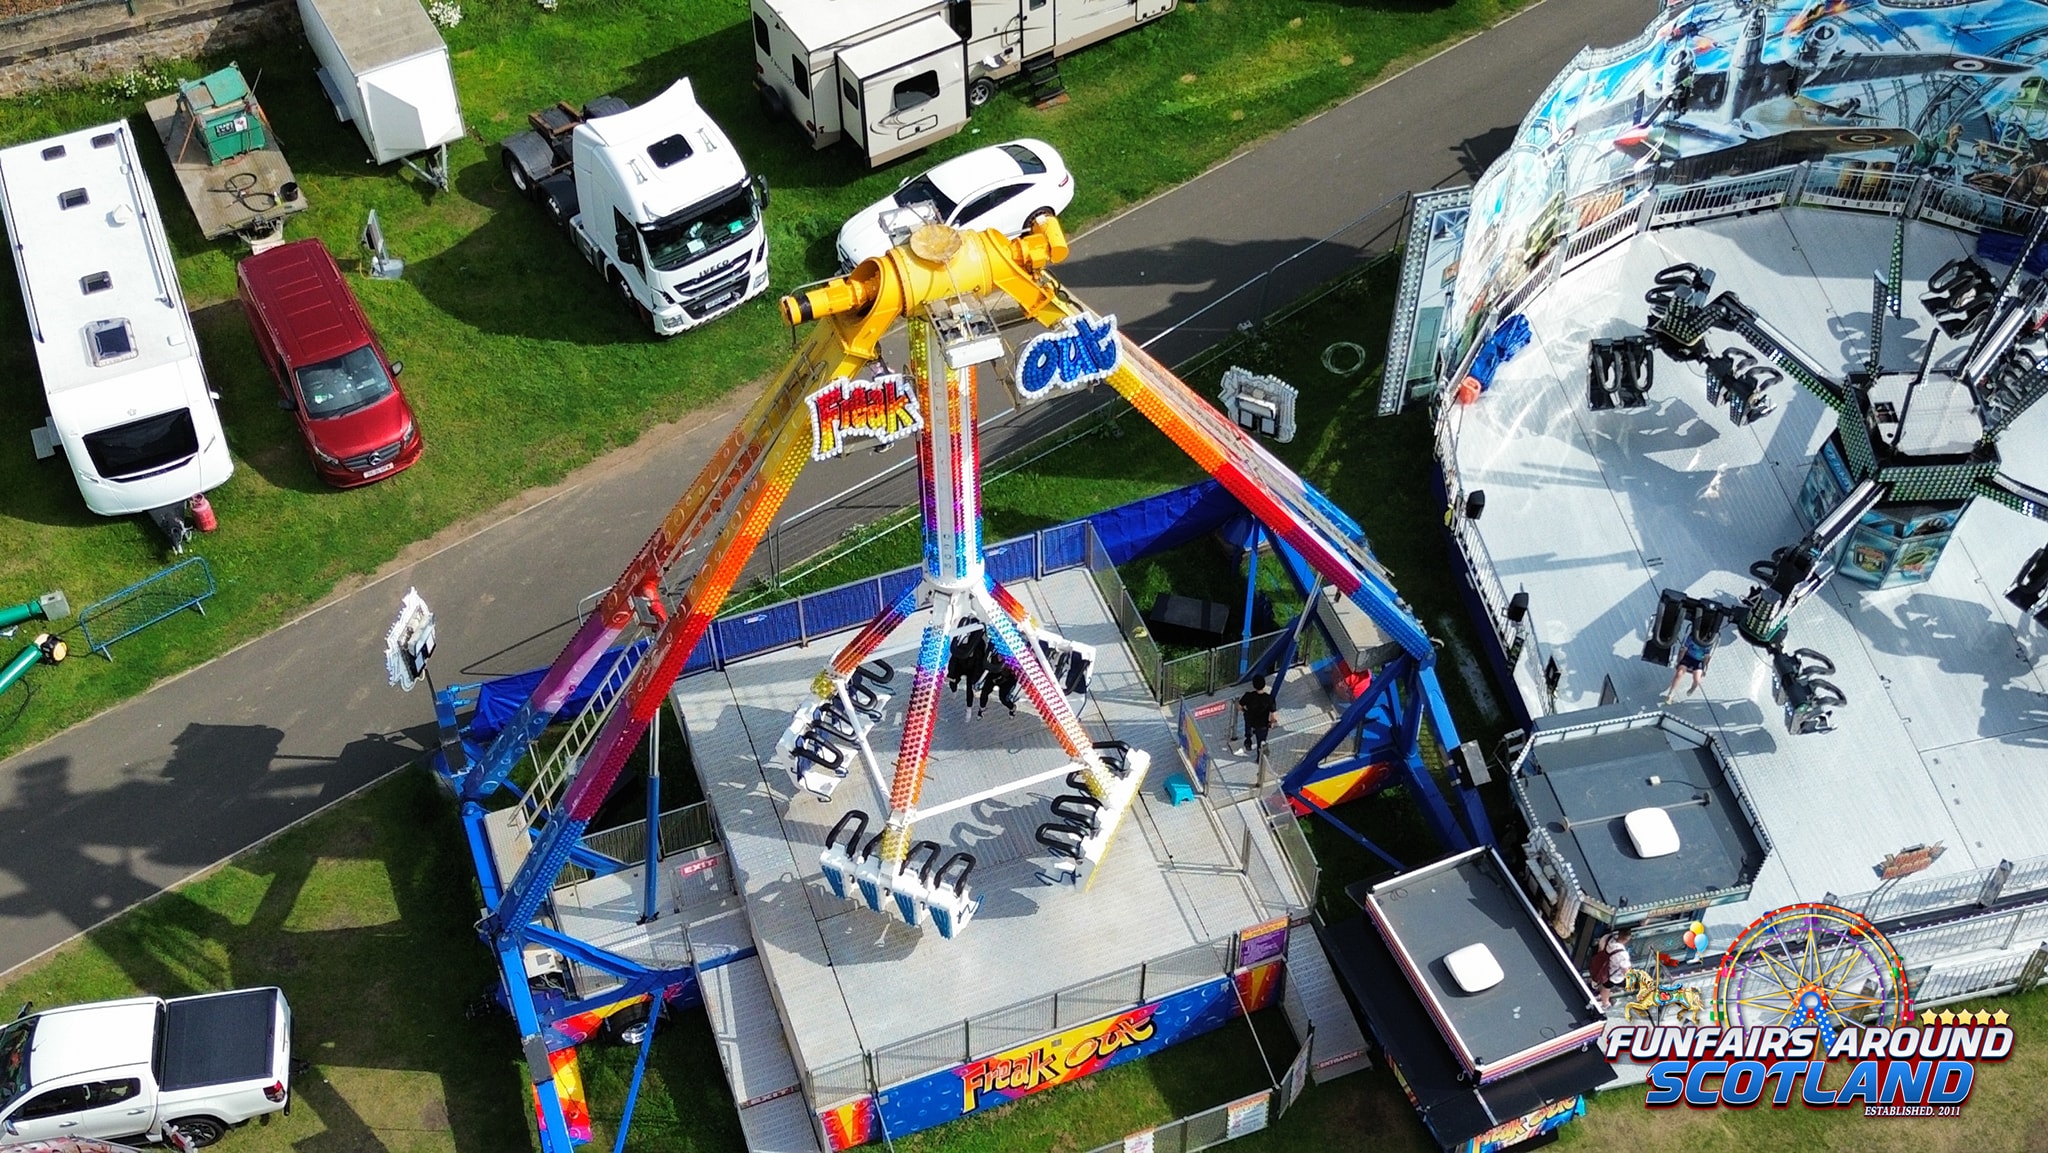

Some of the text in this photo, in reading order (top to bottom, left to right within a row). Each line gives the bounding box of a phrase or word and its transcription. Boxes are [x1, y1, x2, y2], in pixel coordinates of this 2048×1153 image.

[699, 259, 729, 277] IVECO
[815, 381, 916, 454] Freak
[1194, 703, 1226, 718] ENTRANCE
[683, 858, 716, 874] EXIT
[1319, 1051, 1359, 1068] ENTRANCE
[961, 1048, 1059, 1115] Freak
